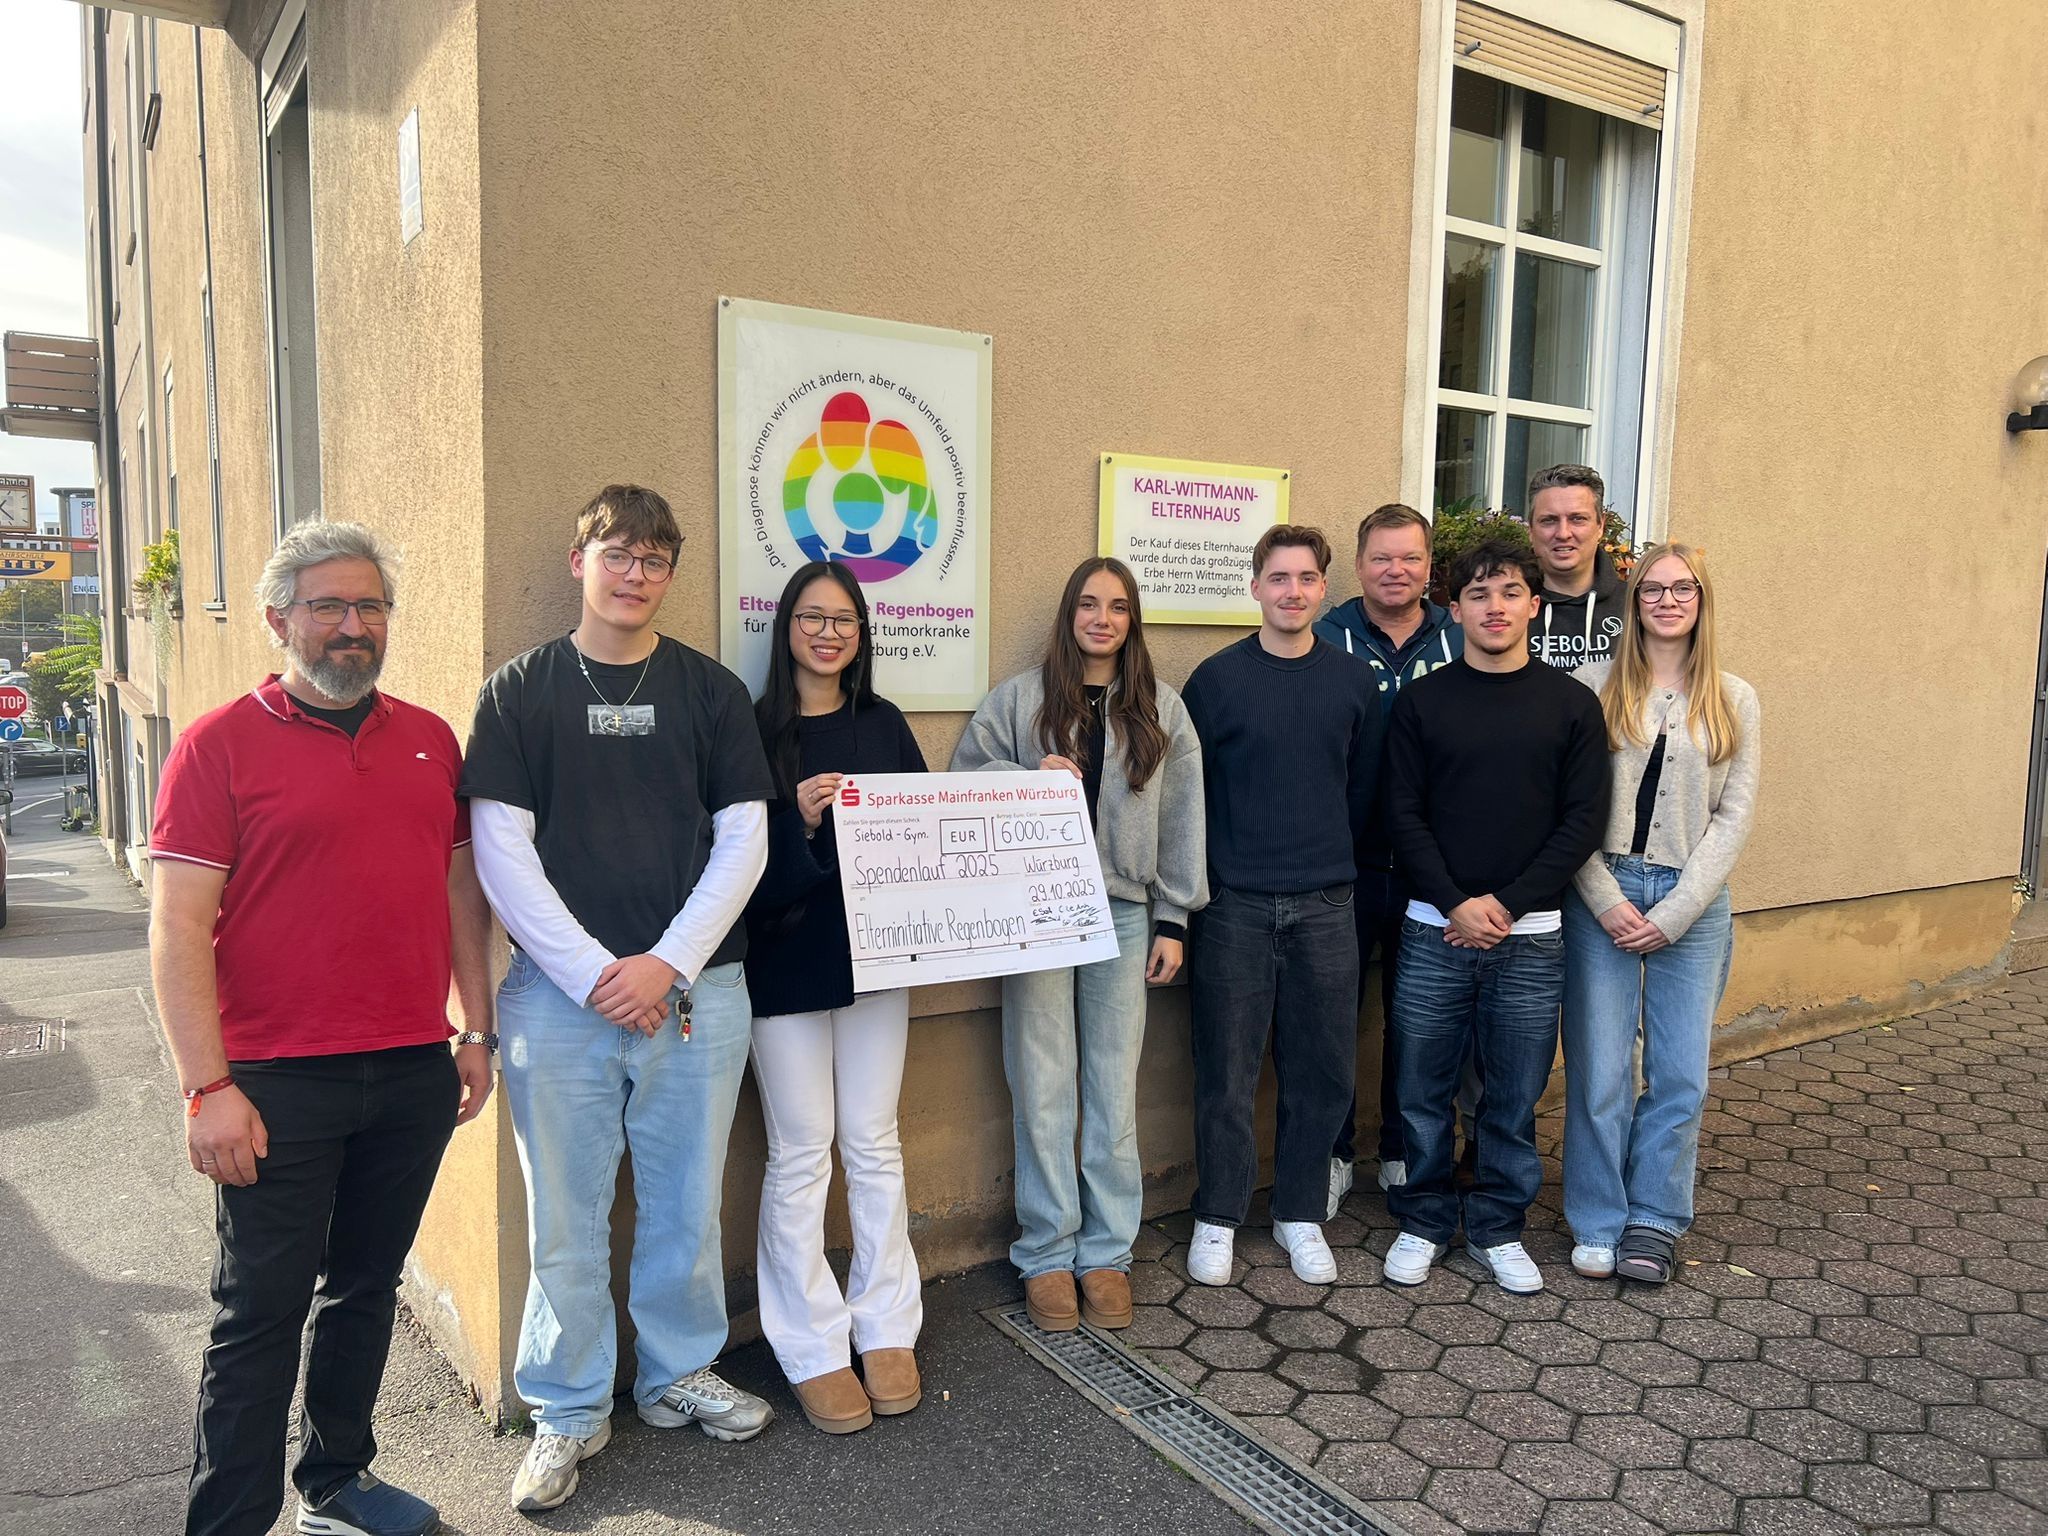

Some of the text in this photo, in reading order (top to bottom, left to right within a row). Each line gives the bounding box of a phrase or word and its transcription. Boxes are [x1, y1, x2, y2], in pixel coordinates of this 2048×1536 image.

[818, 370, 865, 387] ändern,
[868, 373, 896, 390] aber
[788, 379, 818, 404] nicht
[897, 386, 918, 404] das
[771, 400, 788, 421] wir
[918, 400, 952, 443] Umfeld
[748, 421, 775, 473] können
[944, 445, 965, 488] positiv
[0, 478, 25, 487] chule
[1133, 477, 1259, 502] KARL-WITTMANN-
[749, 475, 769, 542] Diagnose
[1151, 501, 1241, 523] ELTERNHAUS
[1130, 537, 1254, 554] Der Kauf dieses Elternhause
[0, 552, 45, 560] AHRSCHULE
[0, 560, 46, 570] ETER
[1129, 553, 1252, 570] wurde durch das großzügig
[1143, 567, 1244, 582] Erbe Herrn Wittmanns
[1138, 582, 1248, 598] im Jahr 2023 ermöglicht.
[876, 601, 974, 621] Regenbogen
[744, 617, 768, 633] für
[882, 623, 971, 638] tumorkranke
[912, 644, 937, 657] e.V.
[1530, 634, 1610, 653] SEBOLD
[0, 695, 25, 710] TOP
[867, 791, 935, 809] Sparkasse
[938, 789, 1013, 804] Mainfranken
[1016, 786, 1078, 801] Würzburg
[854, 828, 894, 842] Siebold
[903, 827, 929, 845] Gym.
[950, 830, 977, 843] EUR
[854, 854, 999, 894] Spendenlauf 2025
[1023, 854, 1080, 877] Würzburg
[1028, 878, 1096, 903] 29.10.2025
[855, 909, 945, 950] Elterninitiative
[945, 907, 1026, 949] Regenbogen
